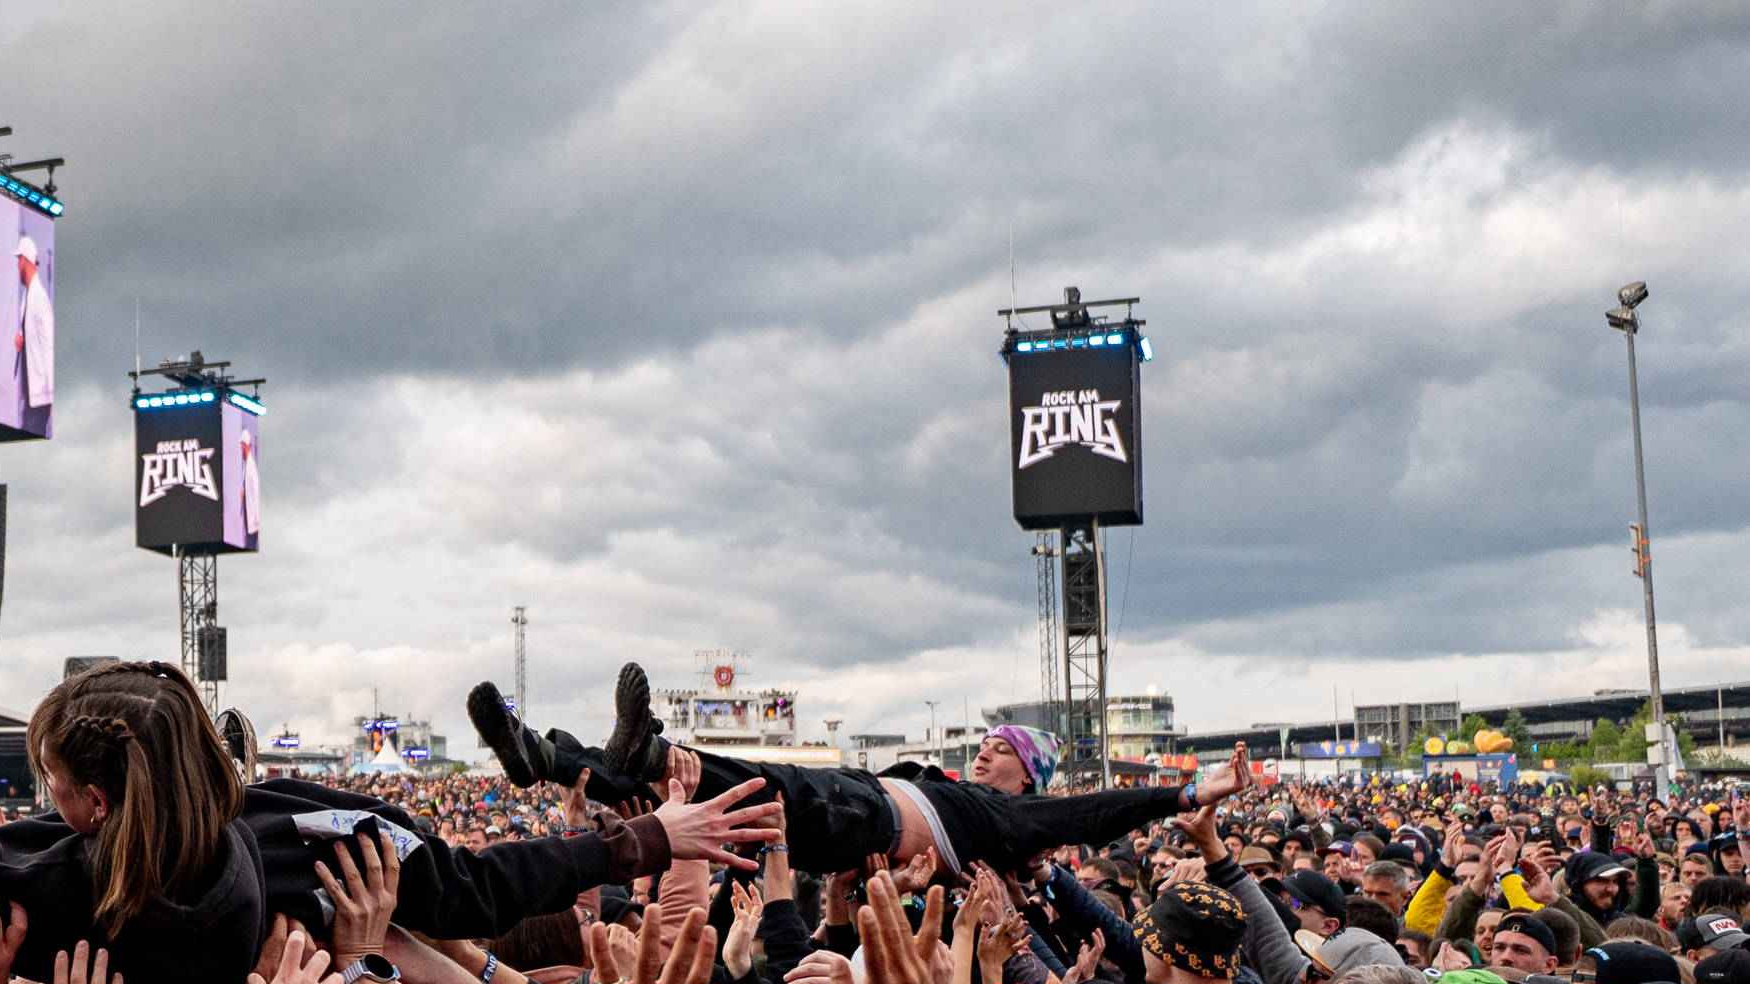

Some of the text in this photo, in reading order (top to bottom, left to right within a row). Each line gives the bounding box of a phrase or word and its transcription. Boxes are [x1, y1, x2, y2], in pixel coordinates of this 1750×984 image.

[1042, 389, 1099, 405] ROCK AM
[157, 439, 199, 453] ROCK AM
[1019, 400, 1127, 469] RING
[140, 448, 219, 507] RING
